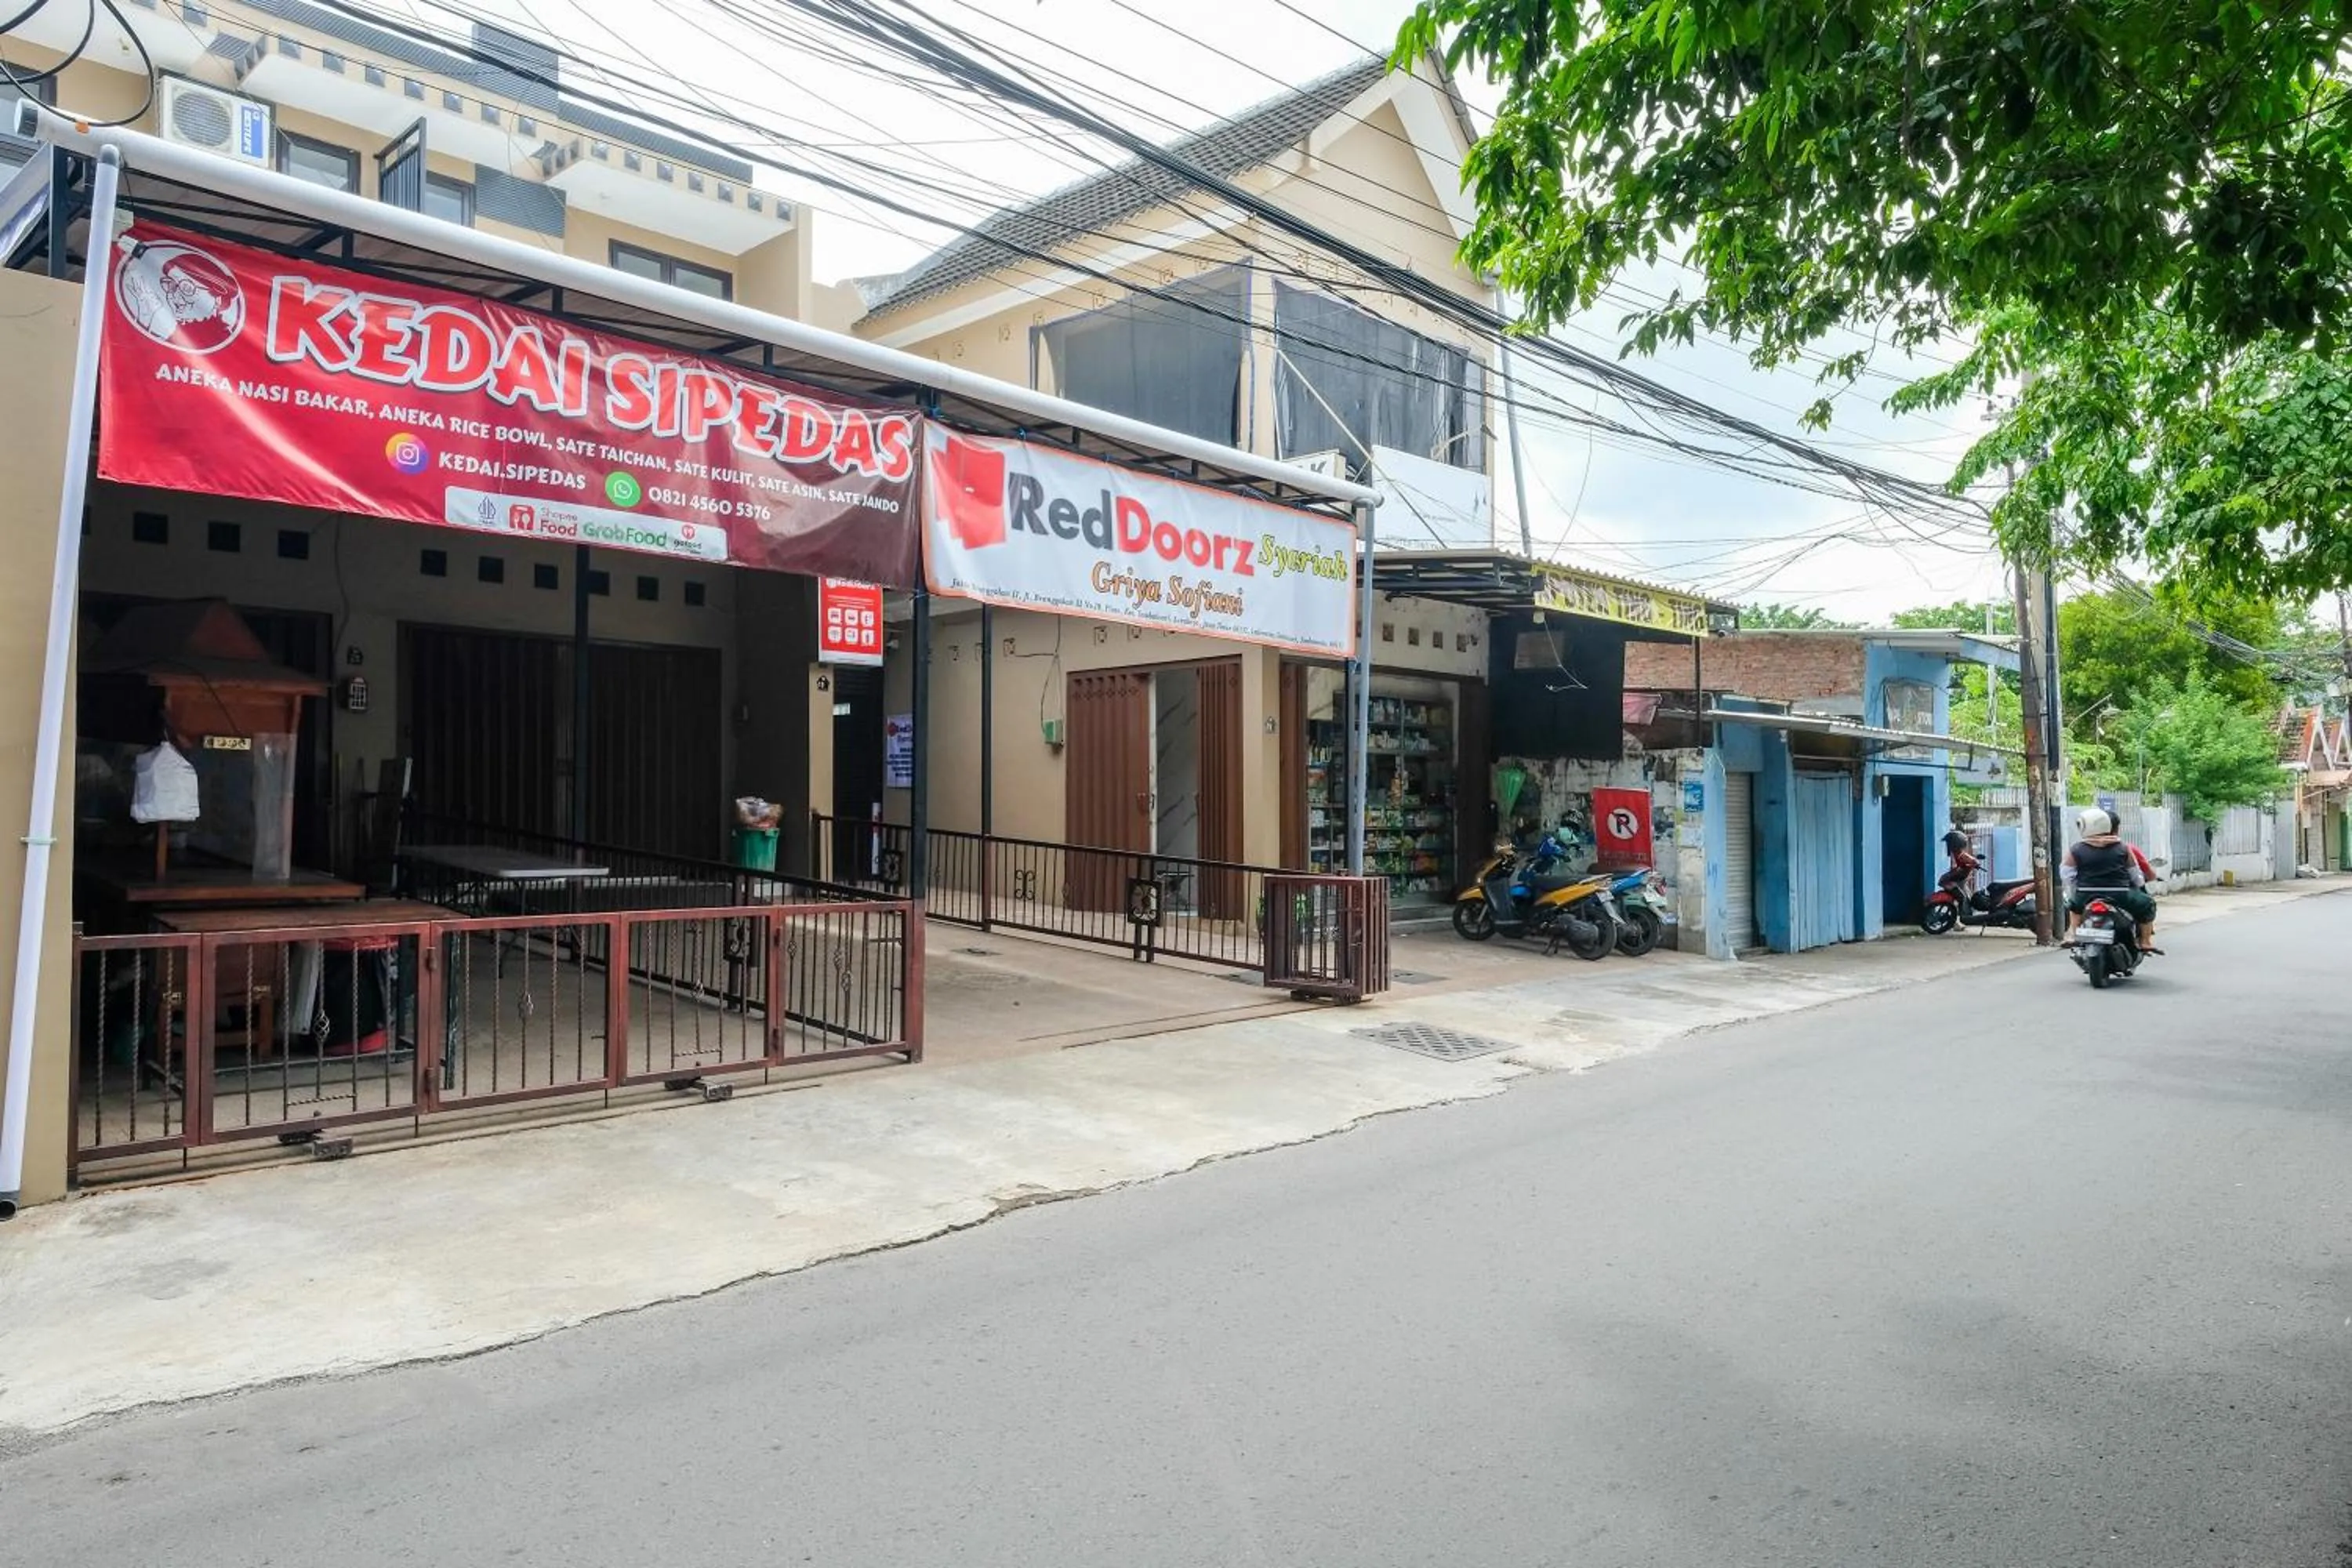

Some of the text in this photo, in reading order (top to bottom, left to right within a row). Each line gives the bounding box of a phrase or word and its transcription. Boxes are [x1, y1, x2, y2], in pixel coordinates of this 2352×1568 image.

[265, 274, 914, 483] KEDAI SIPEDAS
[155, 363, 900, 514] ANEKA NASI BAKAR, ANEKA RICE BOWL, SATE TAICHAN, SATE KULIT, SATE ASIN, SATE JANDO
[437, 451, 587, 491] KEDAI.SIPEDAS
[539, 518, 579, 538] Food
[648, 486, 771, 521] 0821 4560 5376
[1007, 470, 1254, 576] RedDoorz
[583, 521, 668, 547] GrabFood
[1257, 533, 1349, 583] Syariah
[1091, 559, 1246, 619] Griya Sofiani
